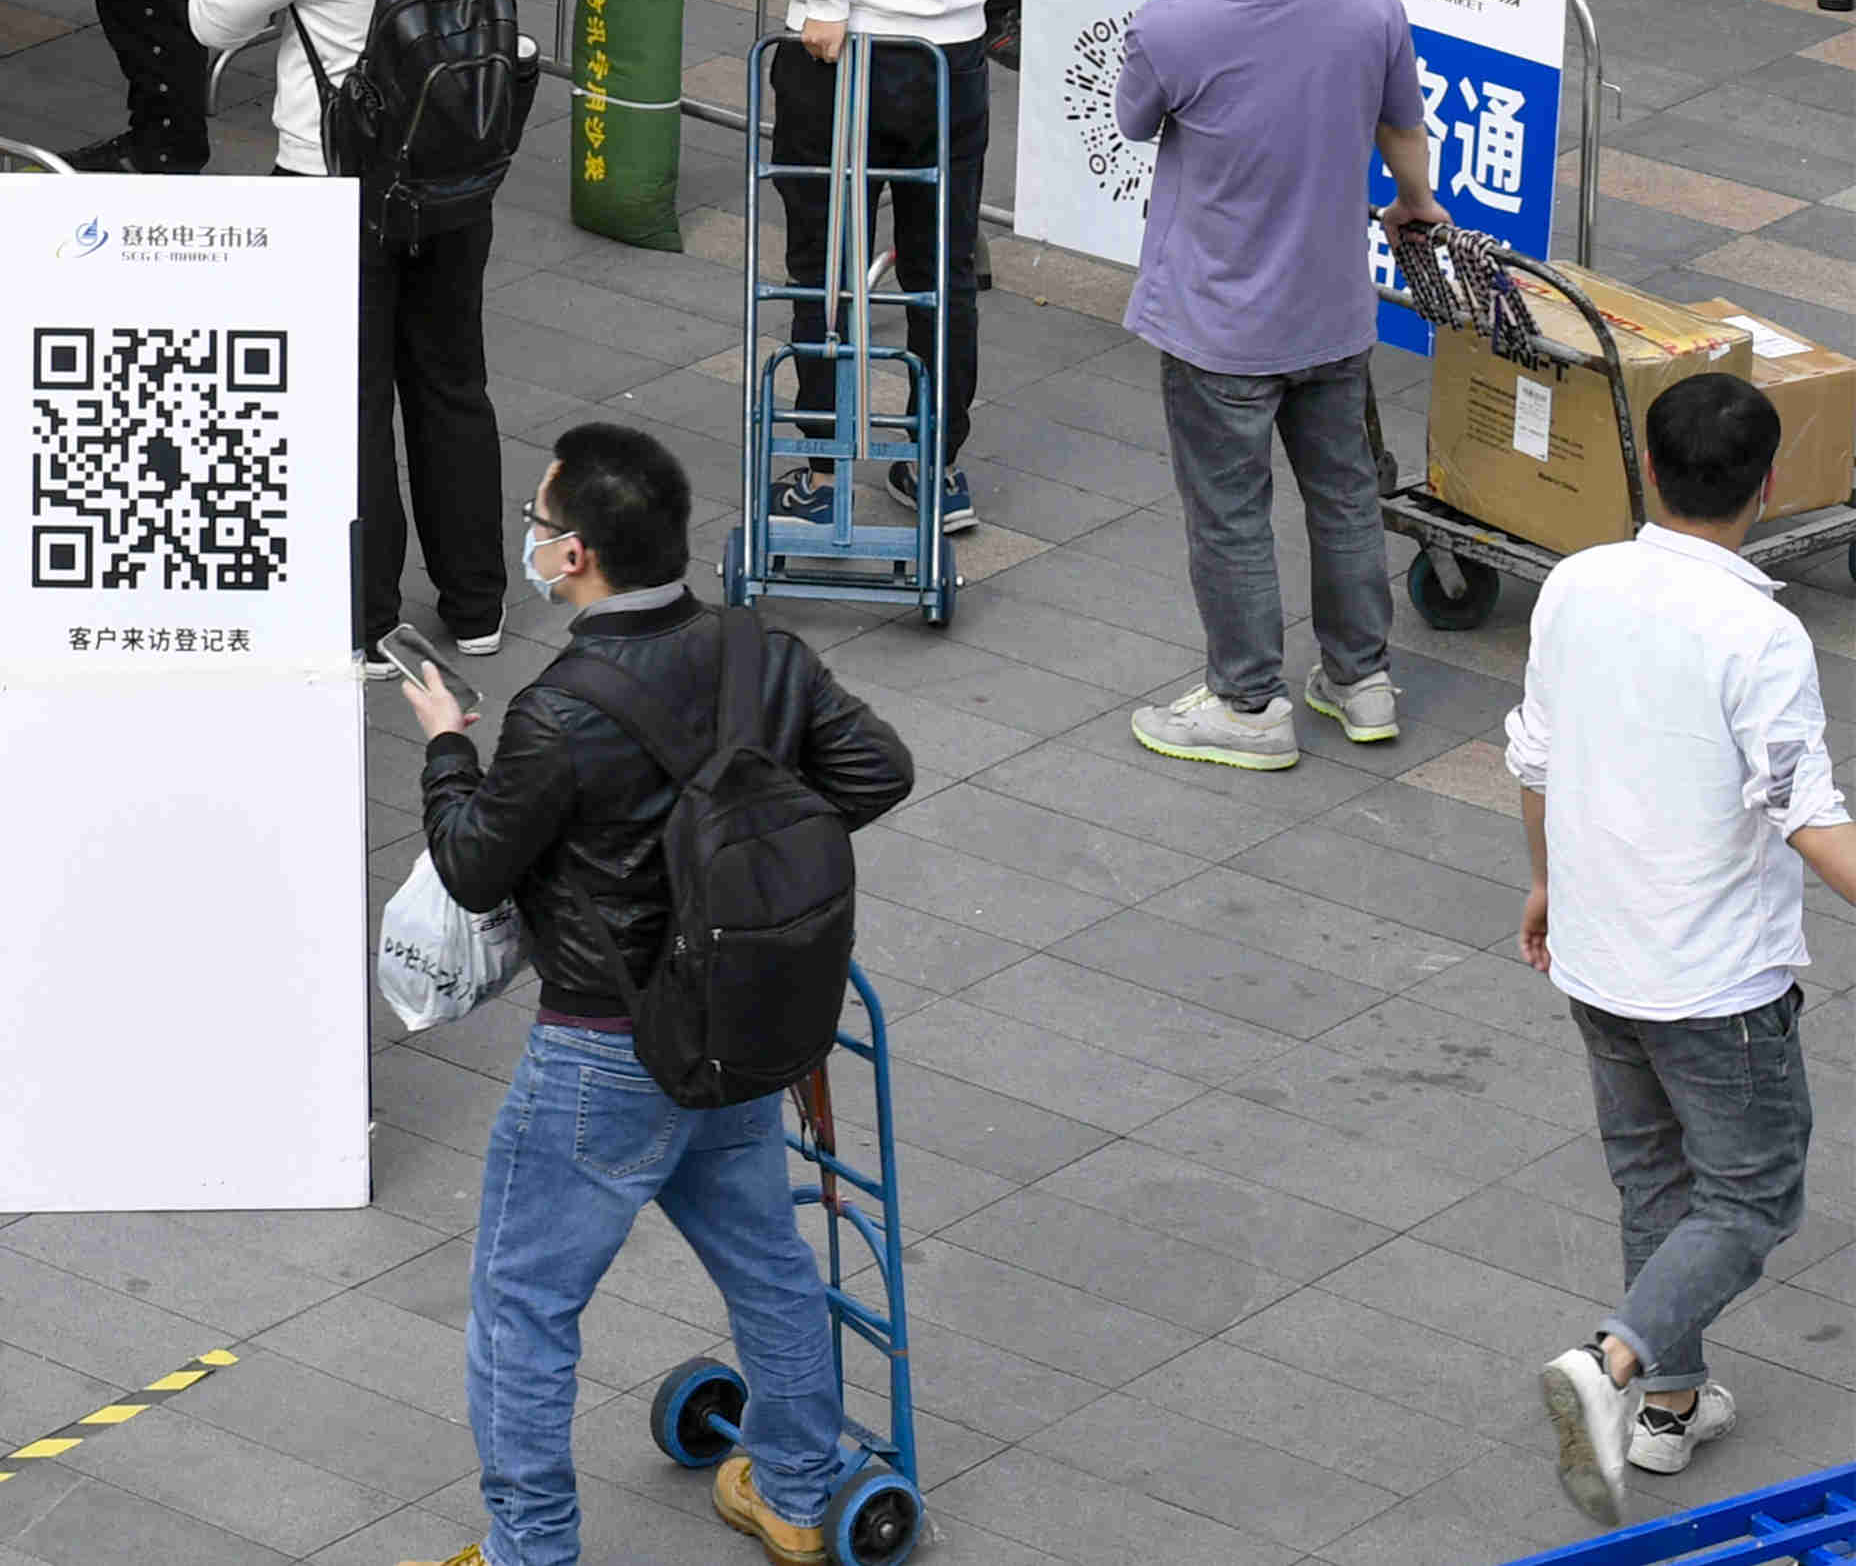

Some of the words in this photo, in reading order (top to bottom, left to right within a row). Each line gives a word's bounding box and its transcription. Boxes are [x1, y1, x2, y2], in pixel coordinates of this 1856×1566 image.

[121, 224, 269, 249] 赛格电子市场
[67, 626, 251, 653] 客户来访登记表
